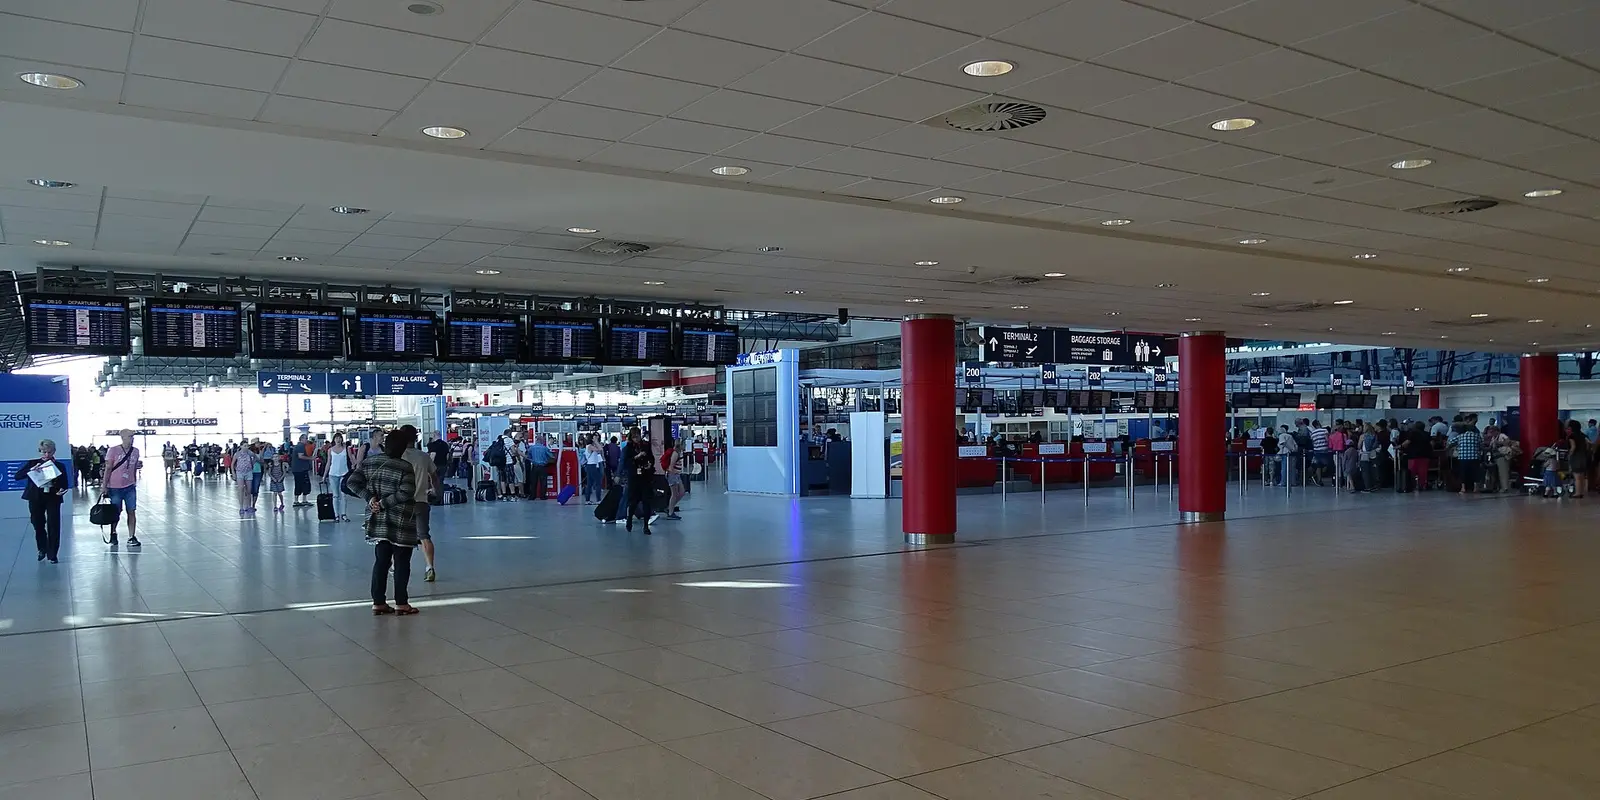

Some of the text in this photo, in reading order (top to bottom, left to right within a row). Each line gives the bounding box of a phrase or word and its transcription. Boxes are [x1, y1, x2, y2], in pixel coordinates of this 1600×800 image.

[1003, 331, 1039, 342] TERMINAL 2
[1071, 335, 1121, 346] BAGGAGE STORAGE
[966, 368, 980, 377] 200
[1043, 370, 1056, 379] 201
[1089, 372, 1101, 381] 202
[1155, 373, 1166, 382] 203
[1333, 378, 1342, 386] 207
